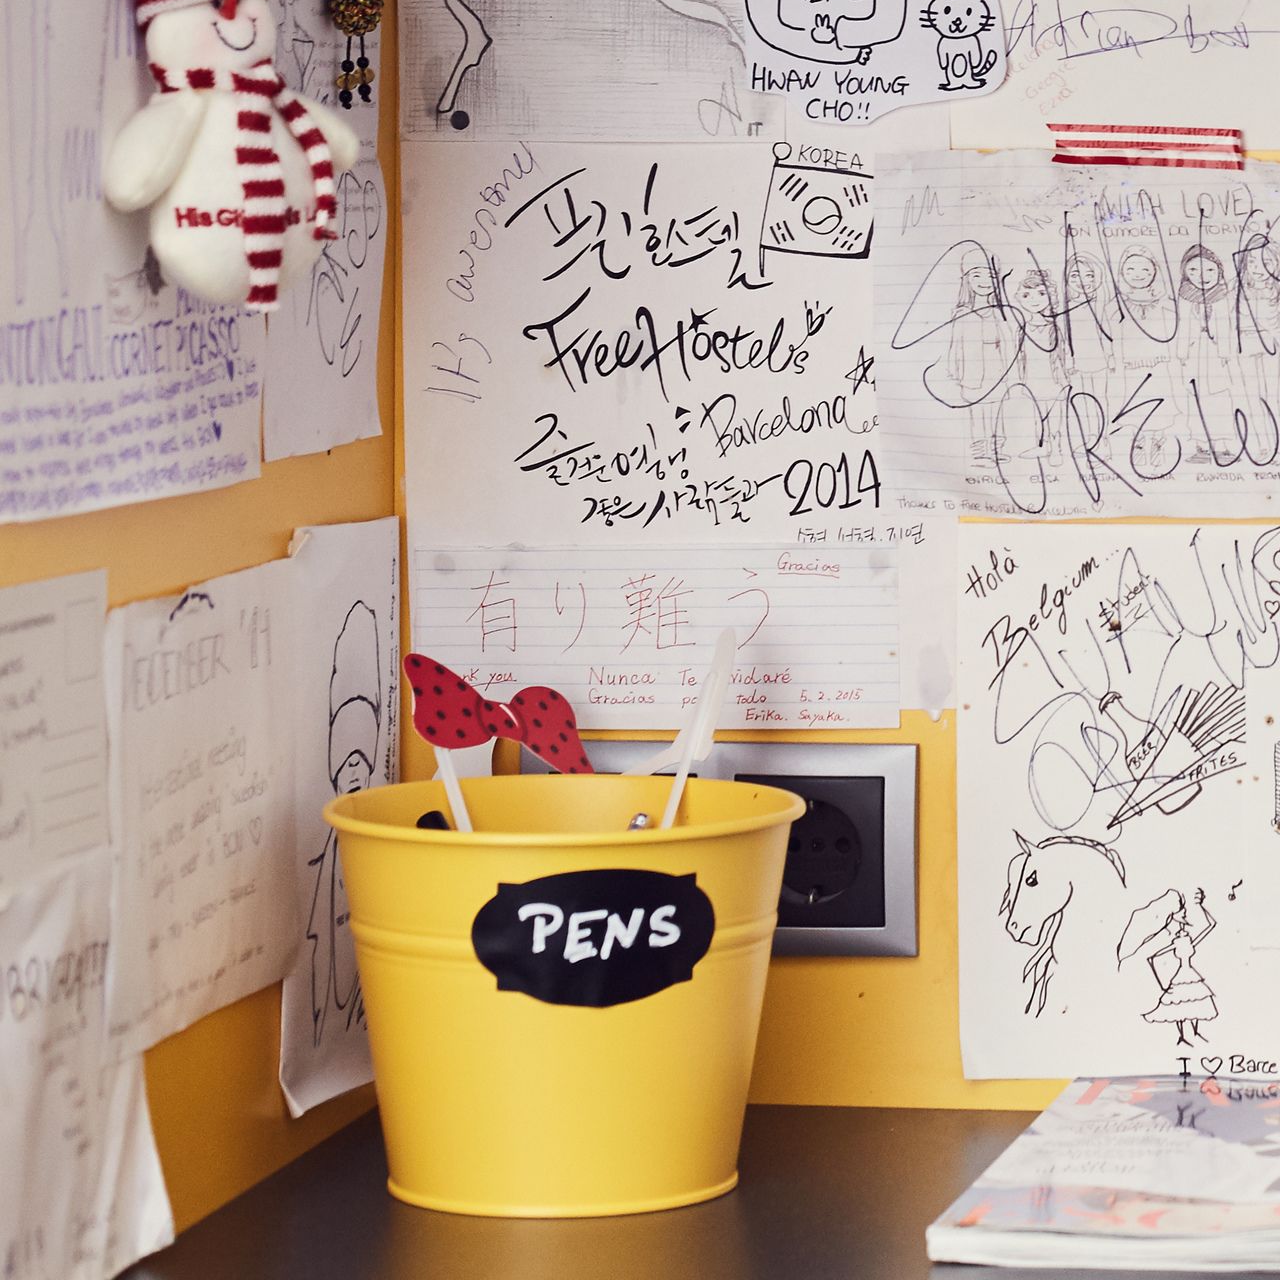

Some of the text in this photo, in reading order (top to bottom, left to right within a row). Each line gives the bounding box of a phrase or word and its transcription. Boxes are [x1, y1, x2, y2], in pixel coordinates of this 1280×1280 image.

[750, 66, 910, 95] HWAN YOUNG
[797, 146, 866, 170] KOREA
[782, 448, 882, 517] 2014
[777, 551, 842, 573] Gracias
[588, 665, 698, 686] Nunca Te
[519, 902, 681, 964] PENS
